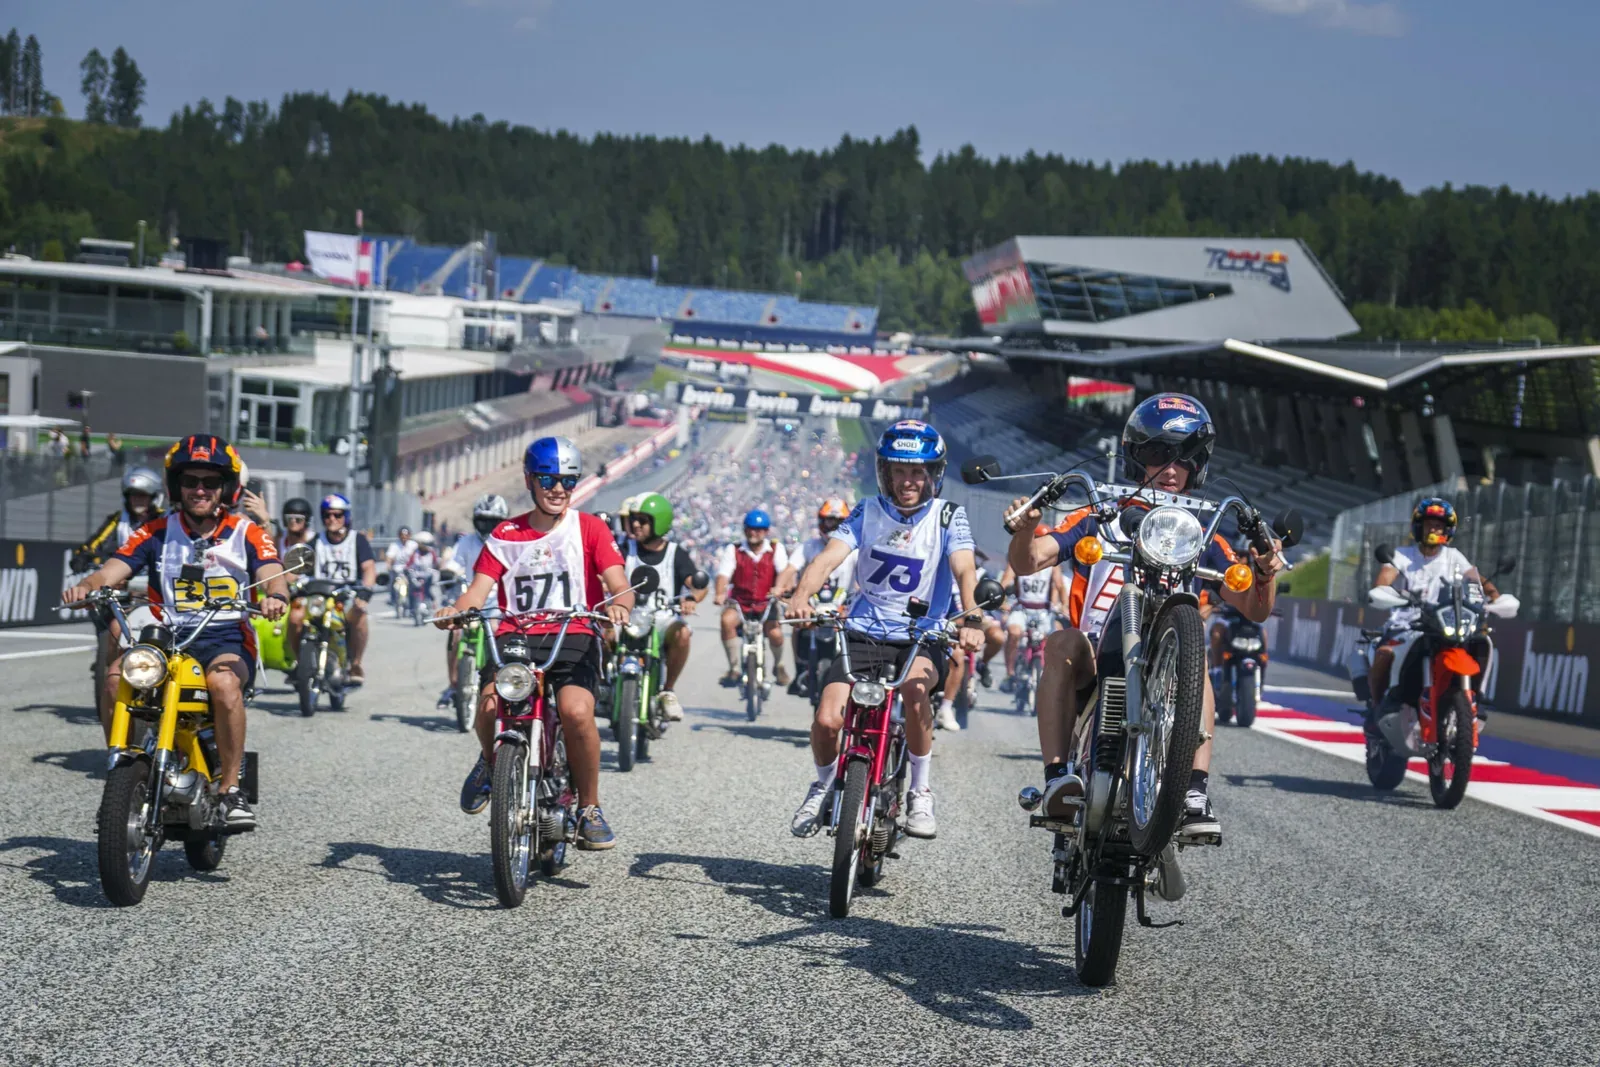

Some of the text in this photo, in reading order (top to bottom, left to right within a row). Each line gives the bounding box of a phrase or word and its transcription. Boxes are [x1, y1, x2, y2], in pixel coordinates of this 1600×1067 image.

[321, 561, 350, 578] 475
[514, 570, 572, 612] 571
[866, 548, 925, 594] 73
[1518, 630, 1589, 715] bwin
